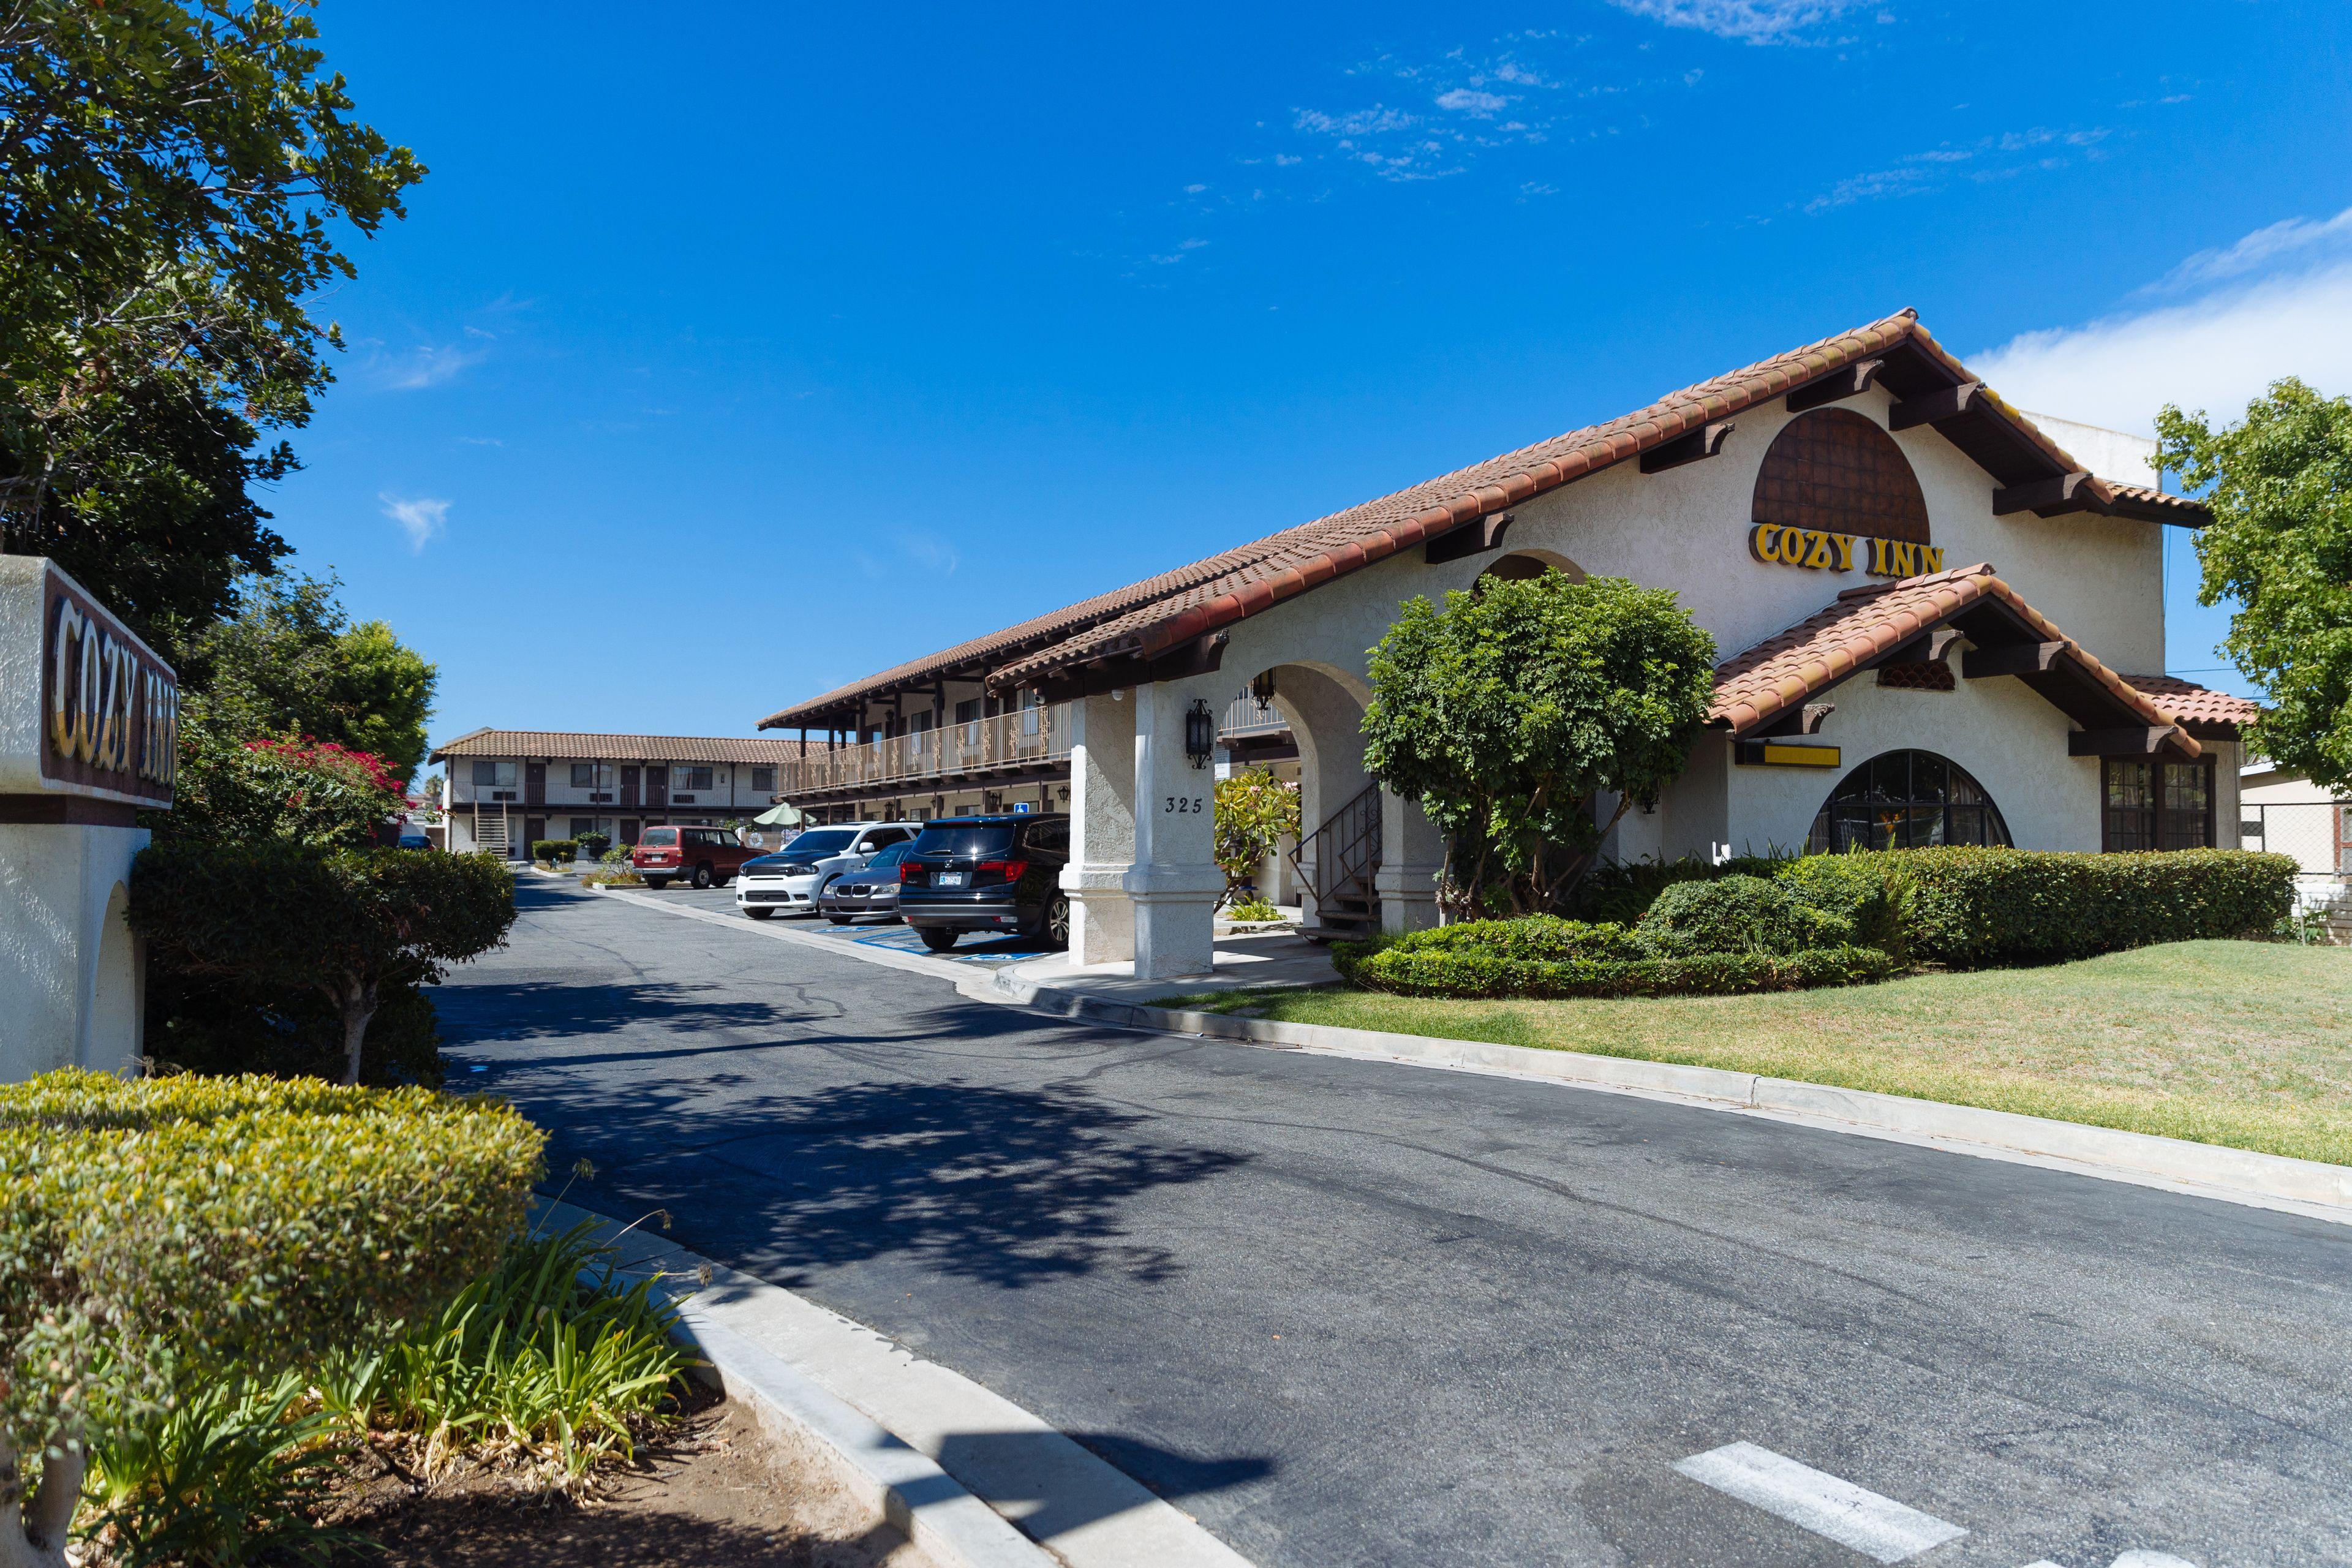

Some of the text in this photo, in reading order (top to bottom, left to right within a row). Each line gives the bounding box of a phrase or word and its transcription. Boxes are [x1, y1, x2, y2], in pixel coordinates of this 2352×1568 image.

[1749, 524, 1944, 577] COZY INN
[53, 597, 179, 786] COZY INN
[1165, 797, 1202, 813] 325
